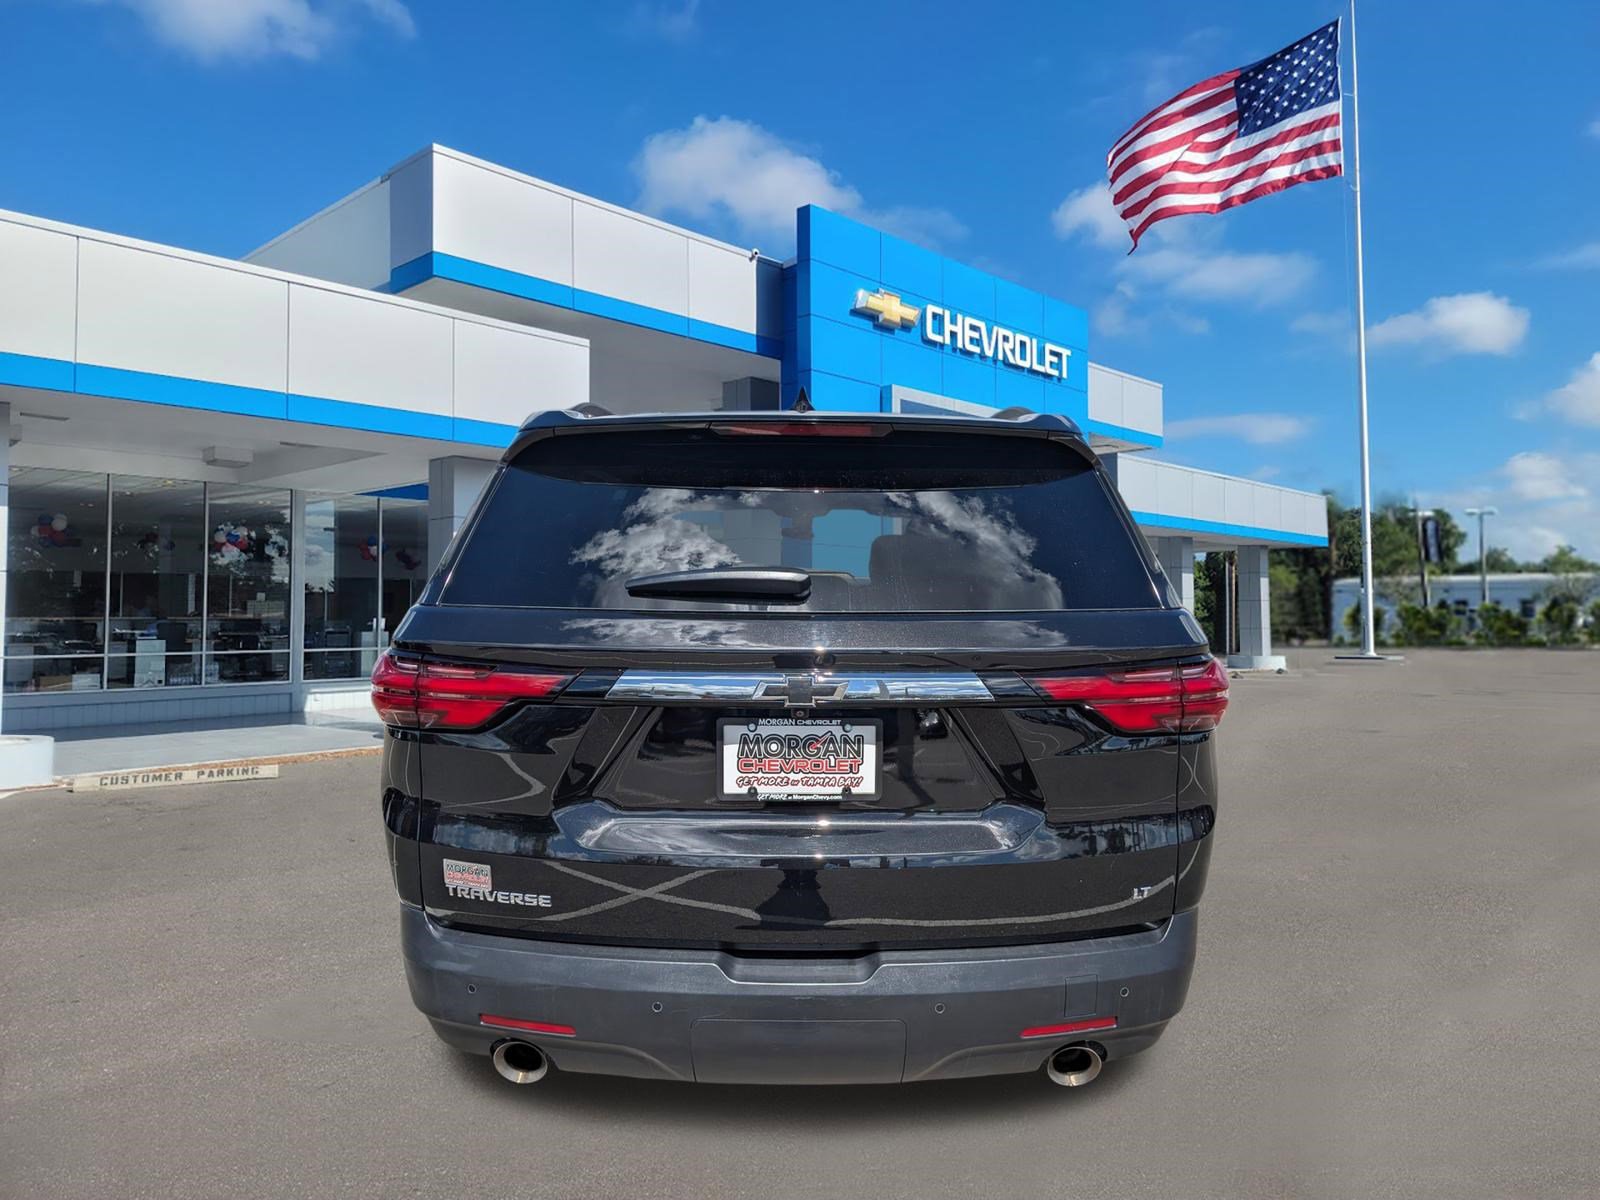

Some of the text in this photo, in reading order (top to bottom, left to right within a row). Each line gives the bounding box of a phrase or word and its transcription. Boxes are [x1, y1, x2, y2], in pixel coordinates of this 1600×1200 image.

[923, 303, 1072, 379] CHEVROLET
[758, 718, 796, 726] MORGAN
[737, 733, 864, 760] MORGAN
[737, 758, 864, 774] CHEVROLET
[99, 766, 259, 787] CUSTOMER PARKING
[736, 776, 758, 788] GET
[757, 776, 789, 787] MORE
[801, 776, 836, 788] TAMPA
[838, 776, 863, 788] BAY!
[792, 793, 843, 801] MorganChevy.com
[445, 884, 552, 907] TRAVERSE
[1133, 886, 1152, 900] LT
